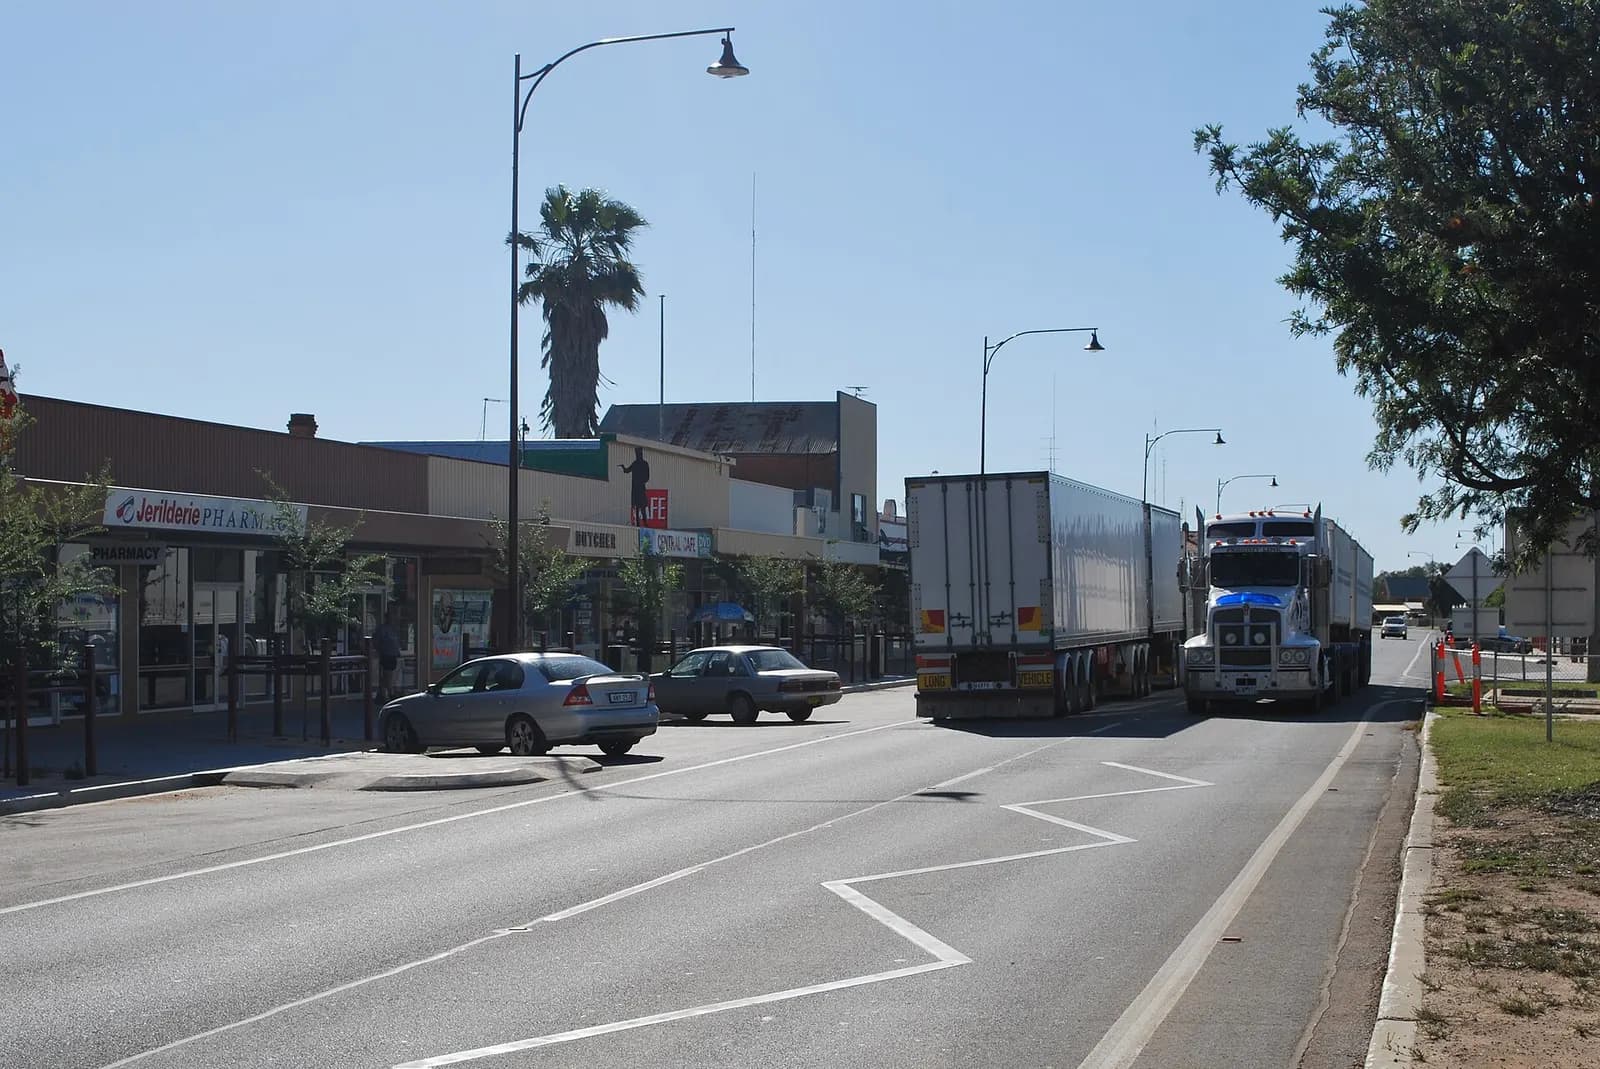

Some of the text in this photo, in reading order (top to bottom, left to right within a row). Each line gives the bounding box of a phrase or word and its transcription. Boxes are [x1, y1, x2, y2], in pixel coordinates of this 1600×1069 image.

[136, 497, 200, 526] Jerilderie
[575, 530, 616, 549] BUTCHER
[657, 534, 696, 552] CENTRAL CAFE
[92, 546, 161, 561] PHARMACY
[923, 674, 945, 688] LONG
[1019, 672, 1051, 686] VEHICLE
